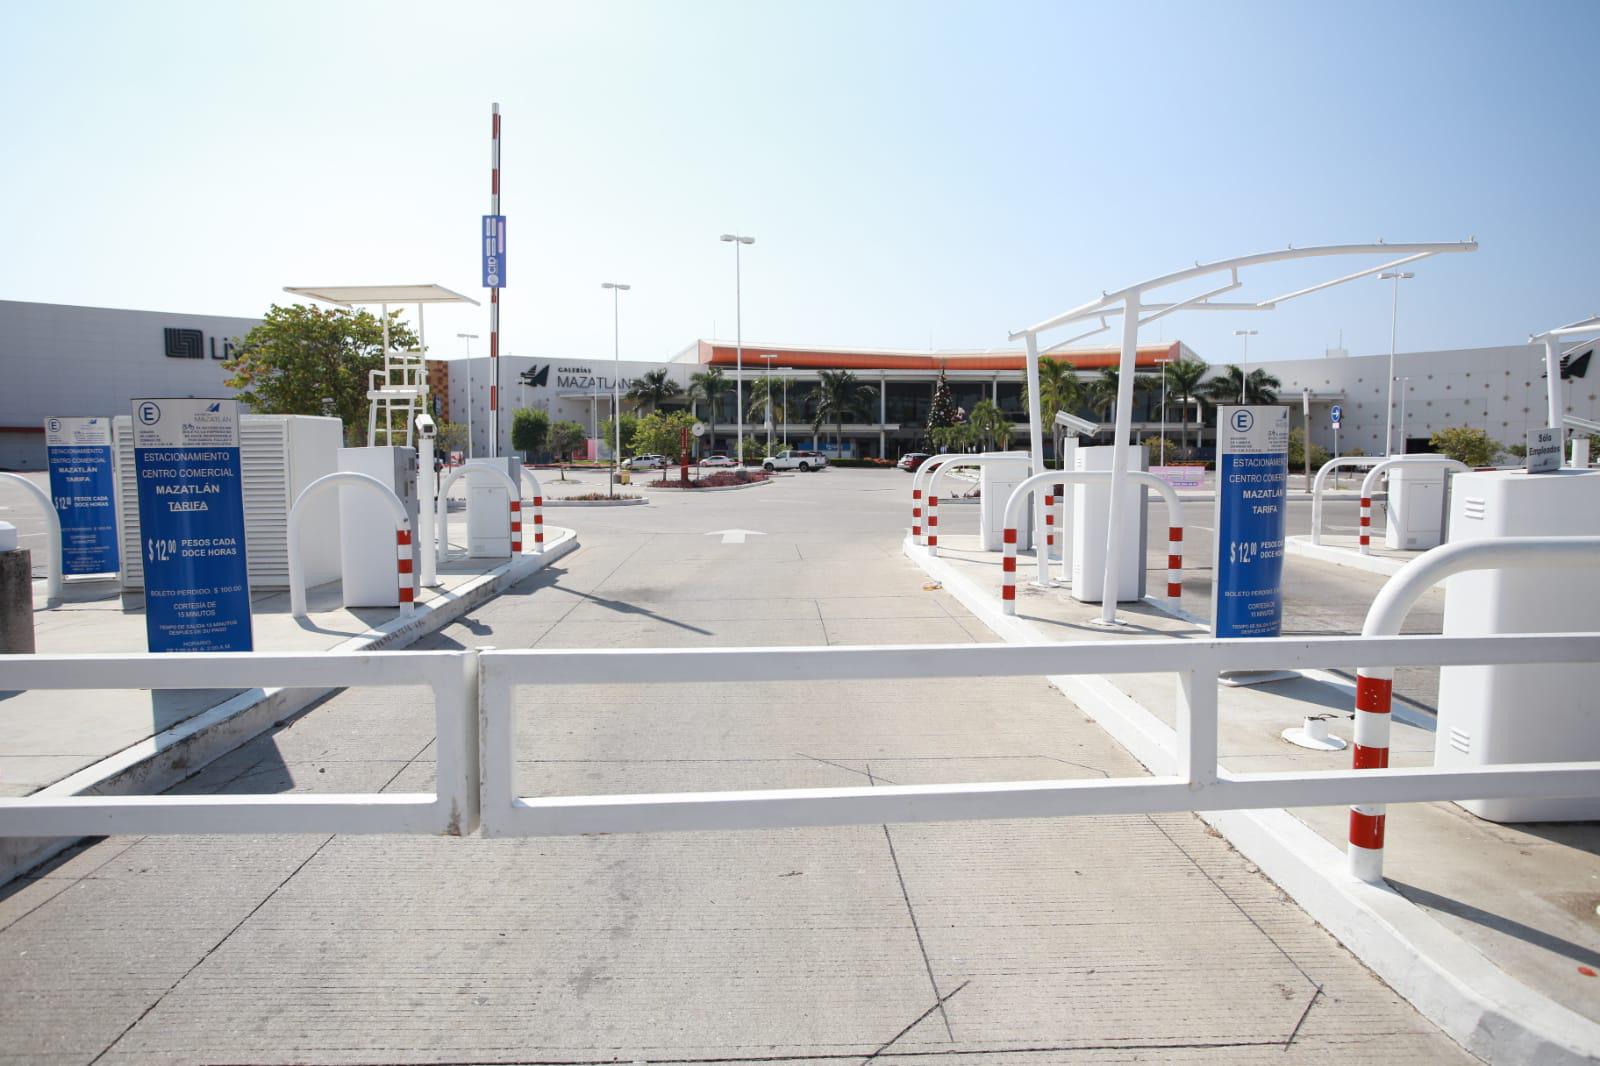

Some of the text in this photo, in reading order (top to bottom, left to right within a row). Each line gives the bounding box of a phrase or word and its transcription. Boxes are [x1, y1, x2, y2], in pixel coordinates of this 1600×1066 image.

[144, 407, 154, 420] E
[1238, 414, 1248, 428] E
[1529, 446, 1560, 456] Empleados
[144, 452, 230, 462] ESTACIONAMIENTO
[142, 468, 234, 478] CENTRO COMERCIAL
[1229, 474, 1262, 483] CENTRO
[156, 482, 220, 494] MAZATLÁN
[168, 502, 208, 511] TARIFA
[1252, 505, 1278, 514] TARIFA
[148, 538, 154, 564] $
